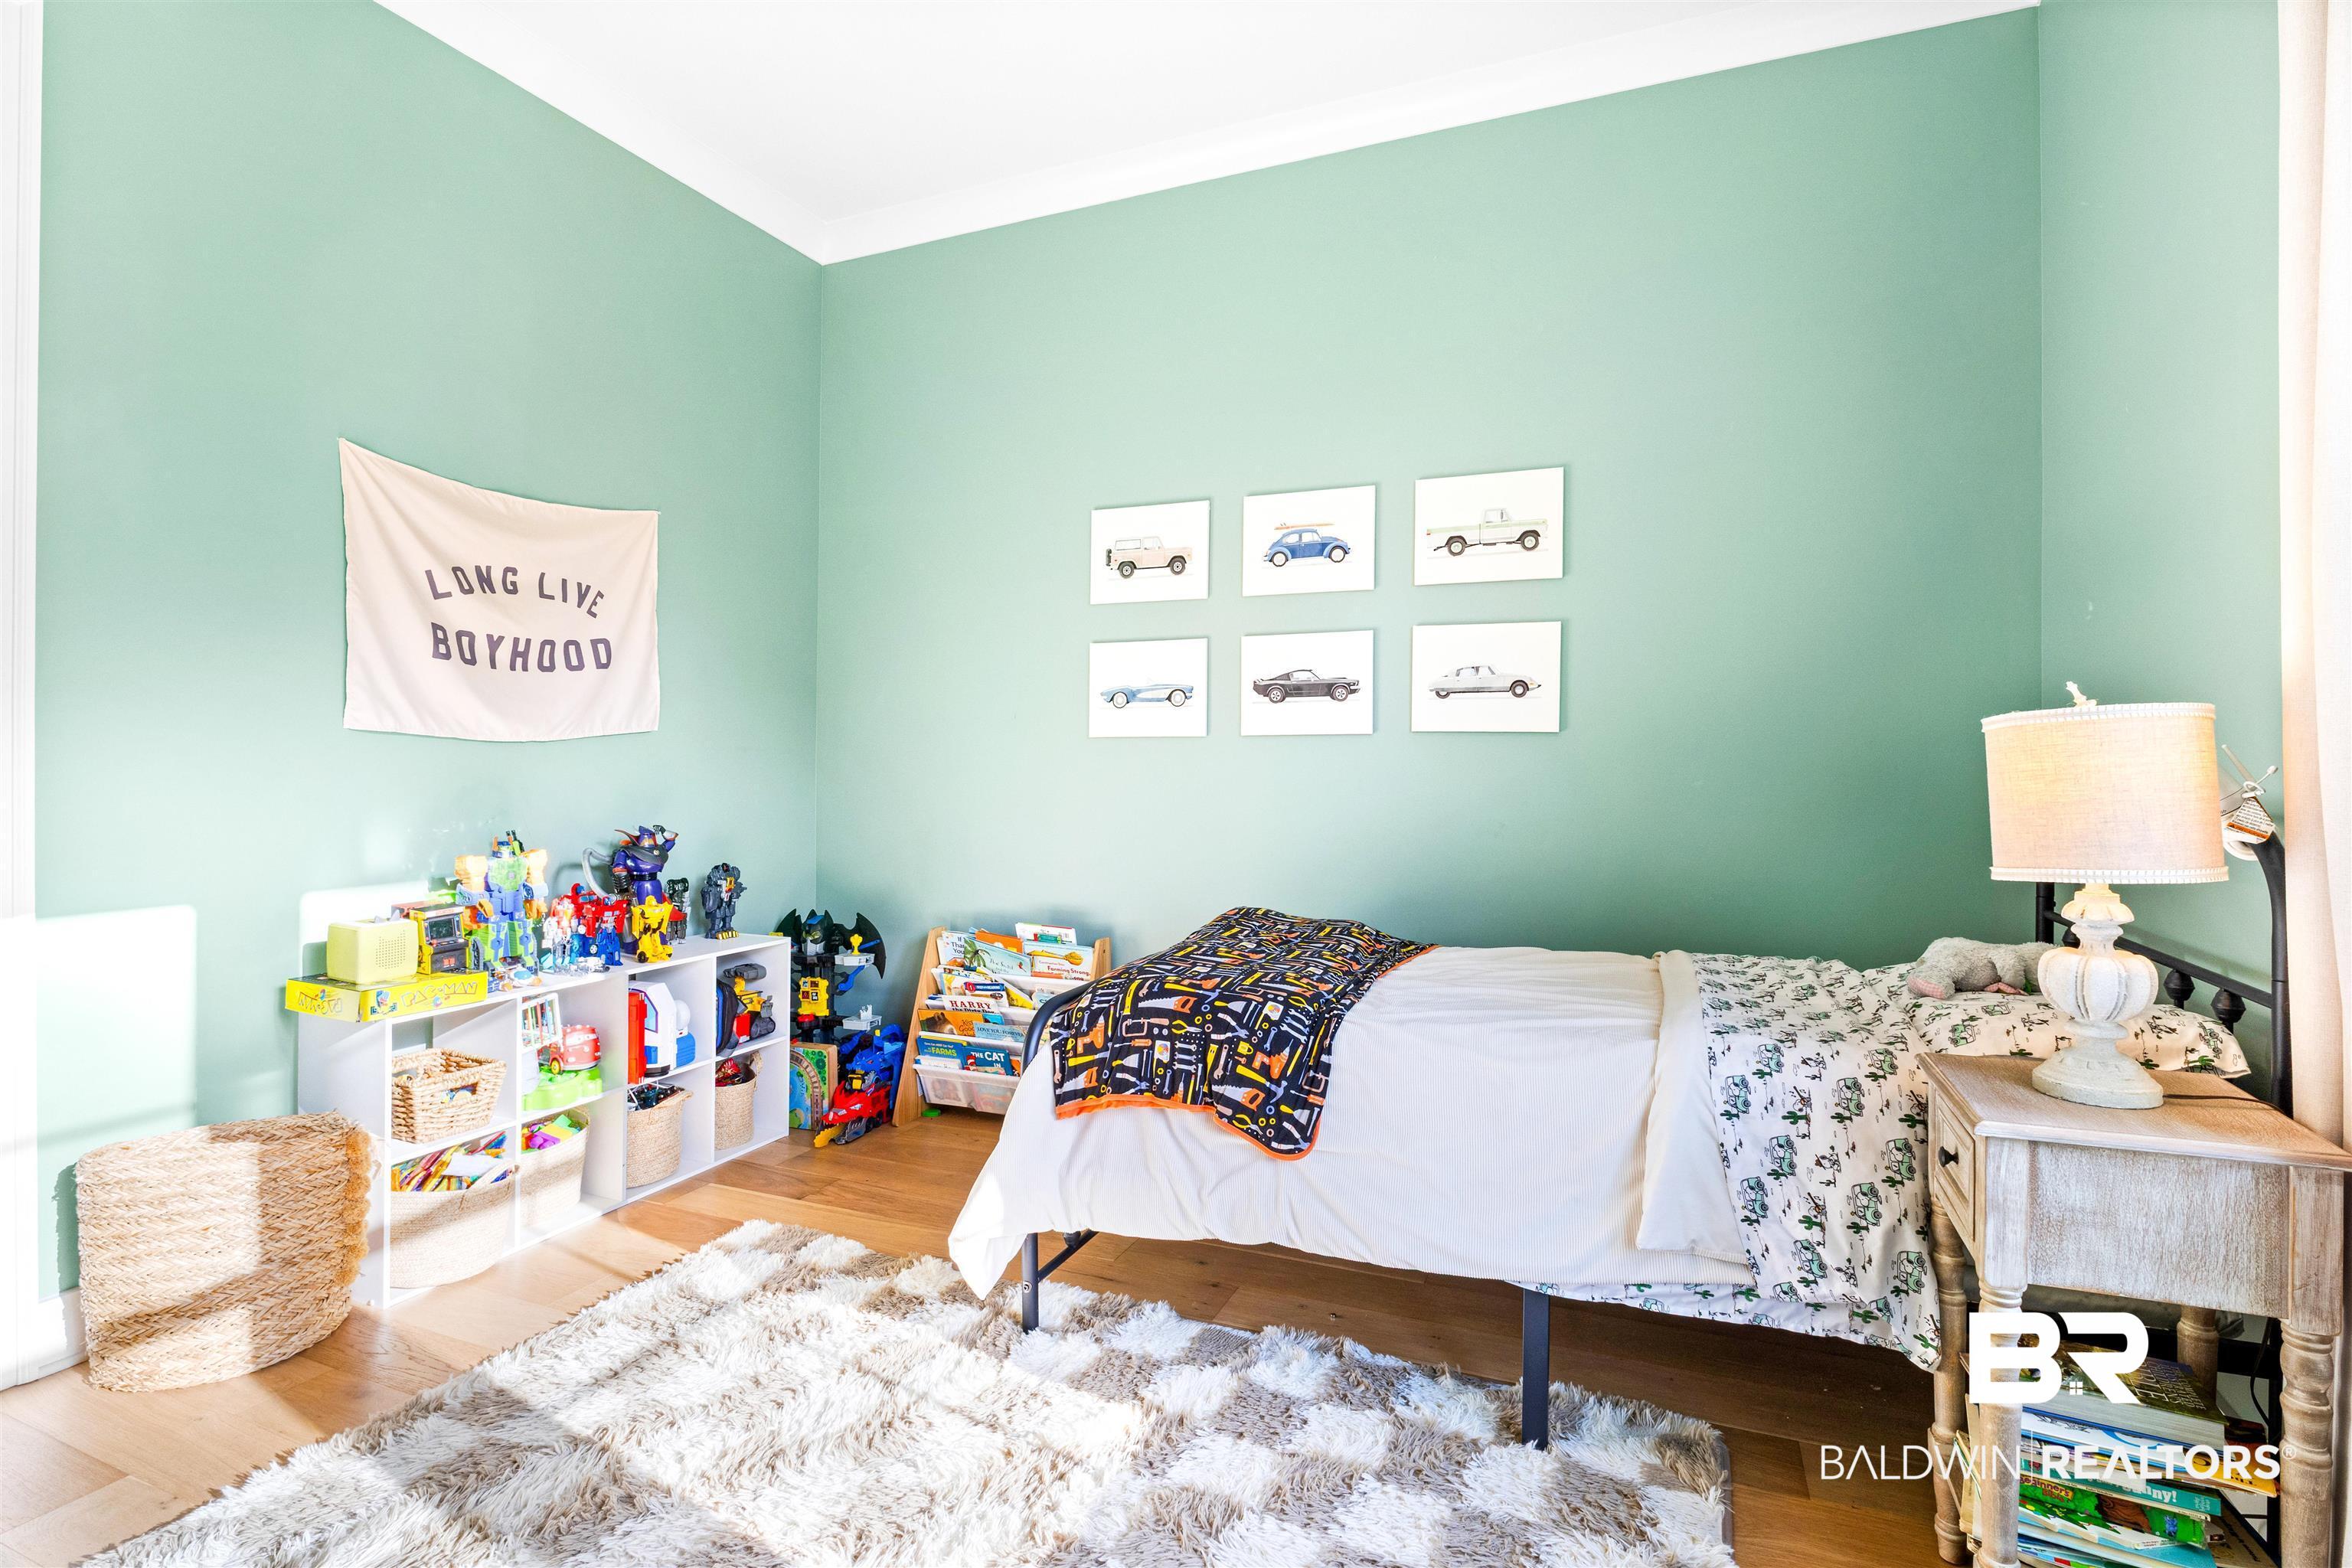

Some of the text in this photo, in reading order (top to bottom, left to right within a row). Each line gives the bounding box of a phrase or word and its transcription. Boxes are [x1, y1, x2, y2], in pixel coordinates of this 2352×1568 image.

[425, 565, 605, 619] LONG LIVE
[431, 622, 612, 673] BOYHOOD
[1047, 965, 1070, 974] Farming
[949, 1000, 991, 1010] HARRY
[932, 1047, 957, 1057] FARMS
[984, 1051, 1005, 1062] CAT
